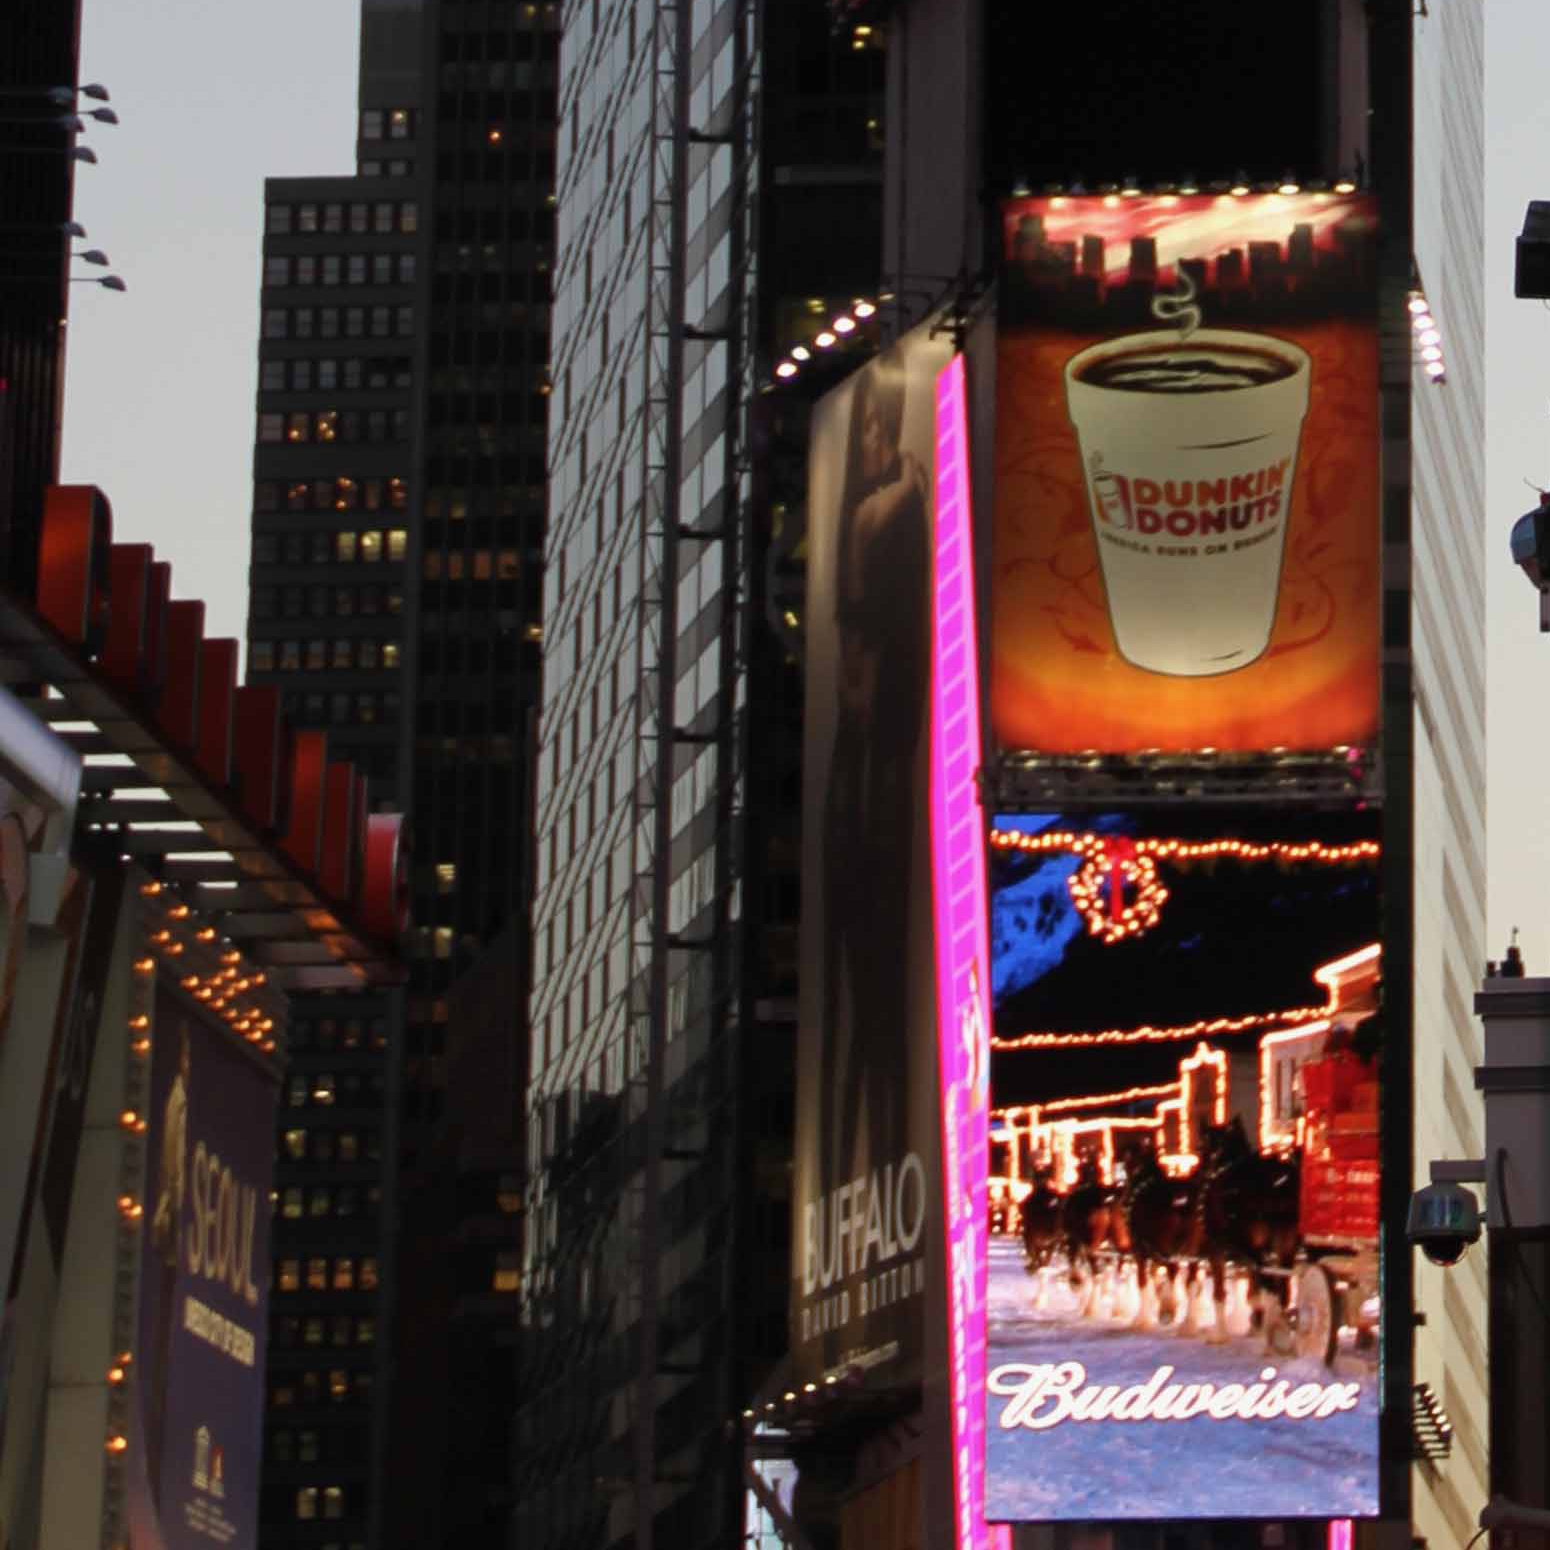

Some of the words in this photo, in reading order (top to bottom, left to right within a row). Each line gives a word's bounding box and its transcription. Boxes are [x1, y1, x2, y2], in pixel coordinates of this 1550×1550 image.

[1134, 489, 1281, 538] DONUTS
[803, 1152, 927, 1297] BUFFALO
[987, 1360, 1360, 1430] Budweiser
